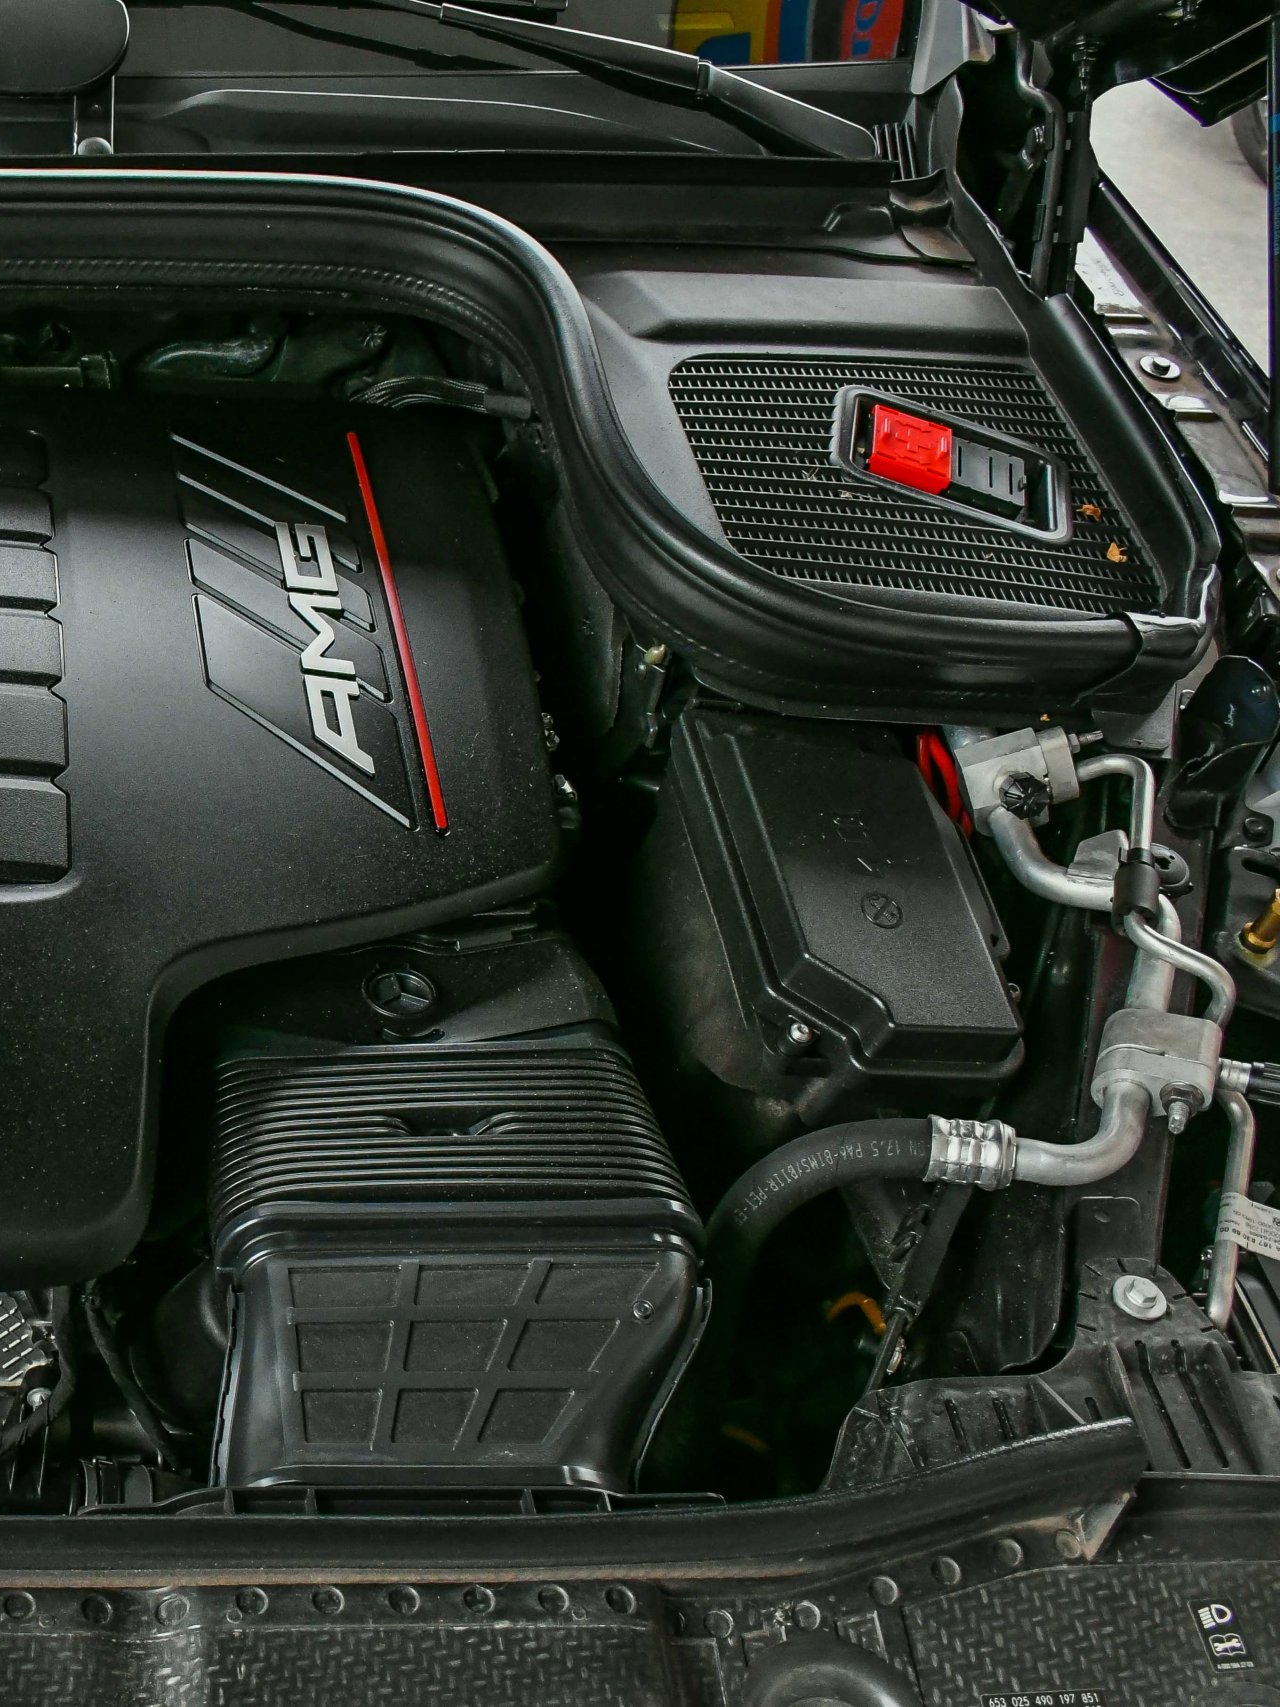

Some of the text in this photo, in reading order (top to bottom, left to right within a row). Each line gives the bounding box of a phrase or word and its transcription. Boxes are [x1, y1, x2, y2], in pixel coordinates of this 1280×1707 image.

[274, 521, 376, 777] AMG
[988, 1692, 1099, 1707] 653 025 490 197 851
